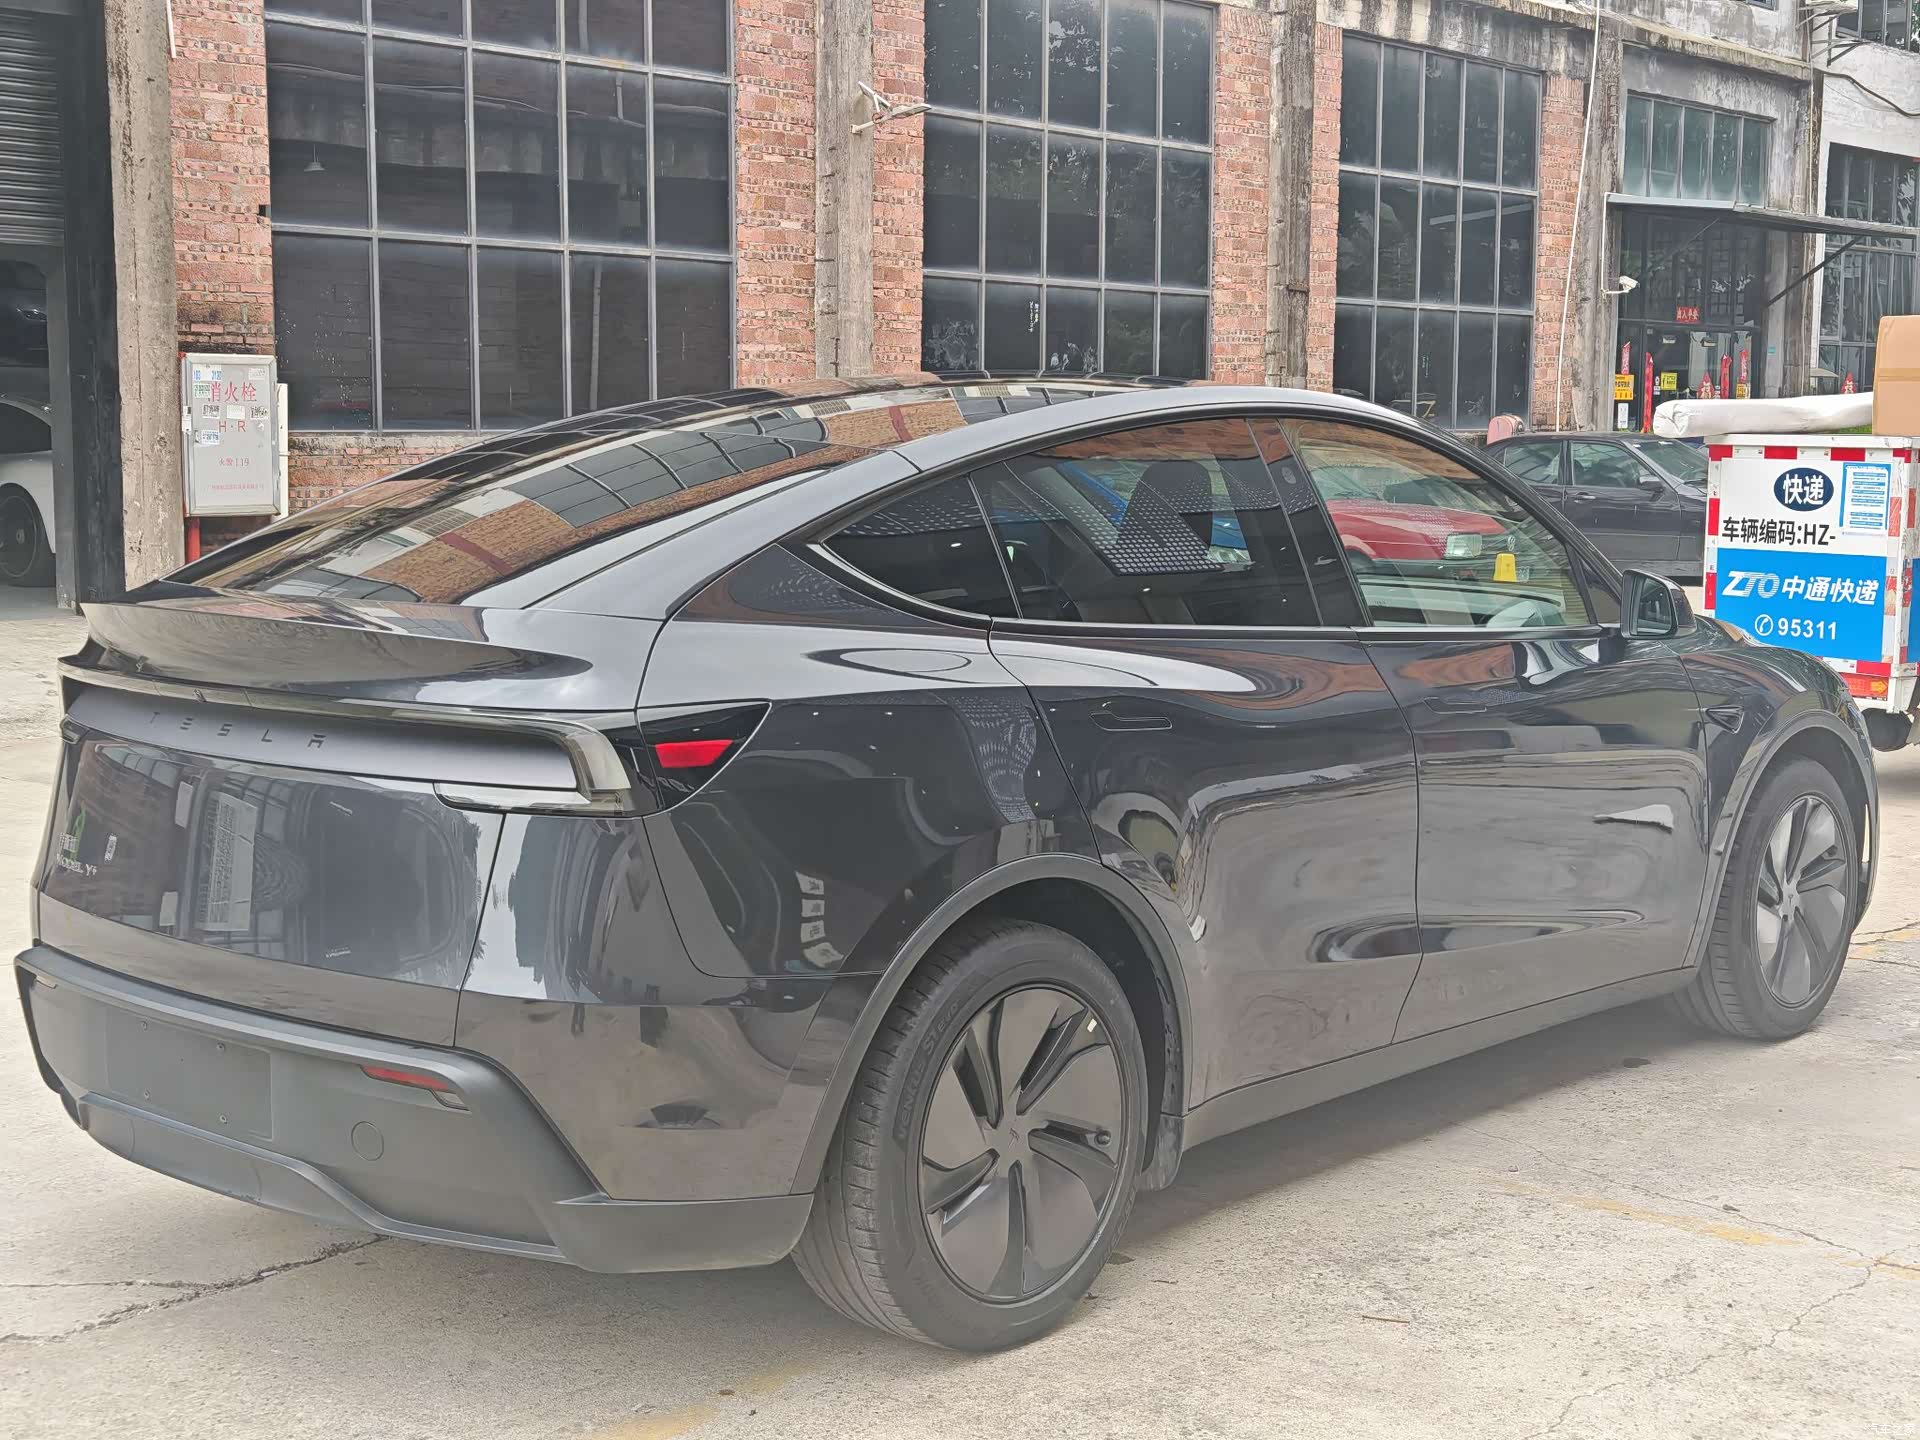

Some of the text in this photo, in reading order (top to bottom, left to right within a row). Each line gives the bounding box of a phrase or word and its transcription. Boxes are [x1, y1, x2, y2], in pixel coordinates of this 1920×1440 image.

[1783, 474, 1825, 505] 快递
[1722, 570, 1879, 605] ZTO 中通快递
[1778, 617, 1837, 640] 95311
[149, 711, 326, 748] TESLA
